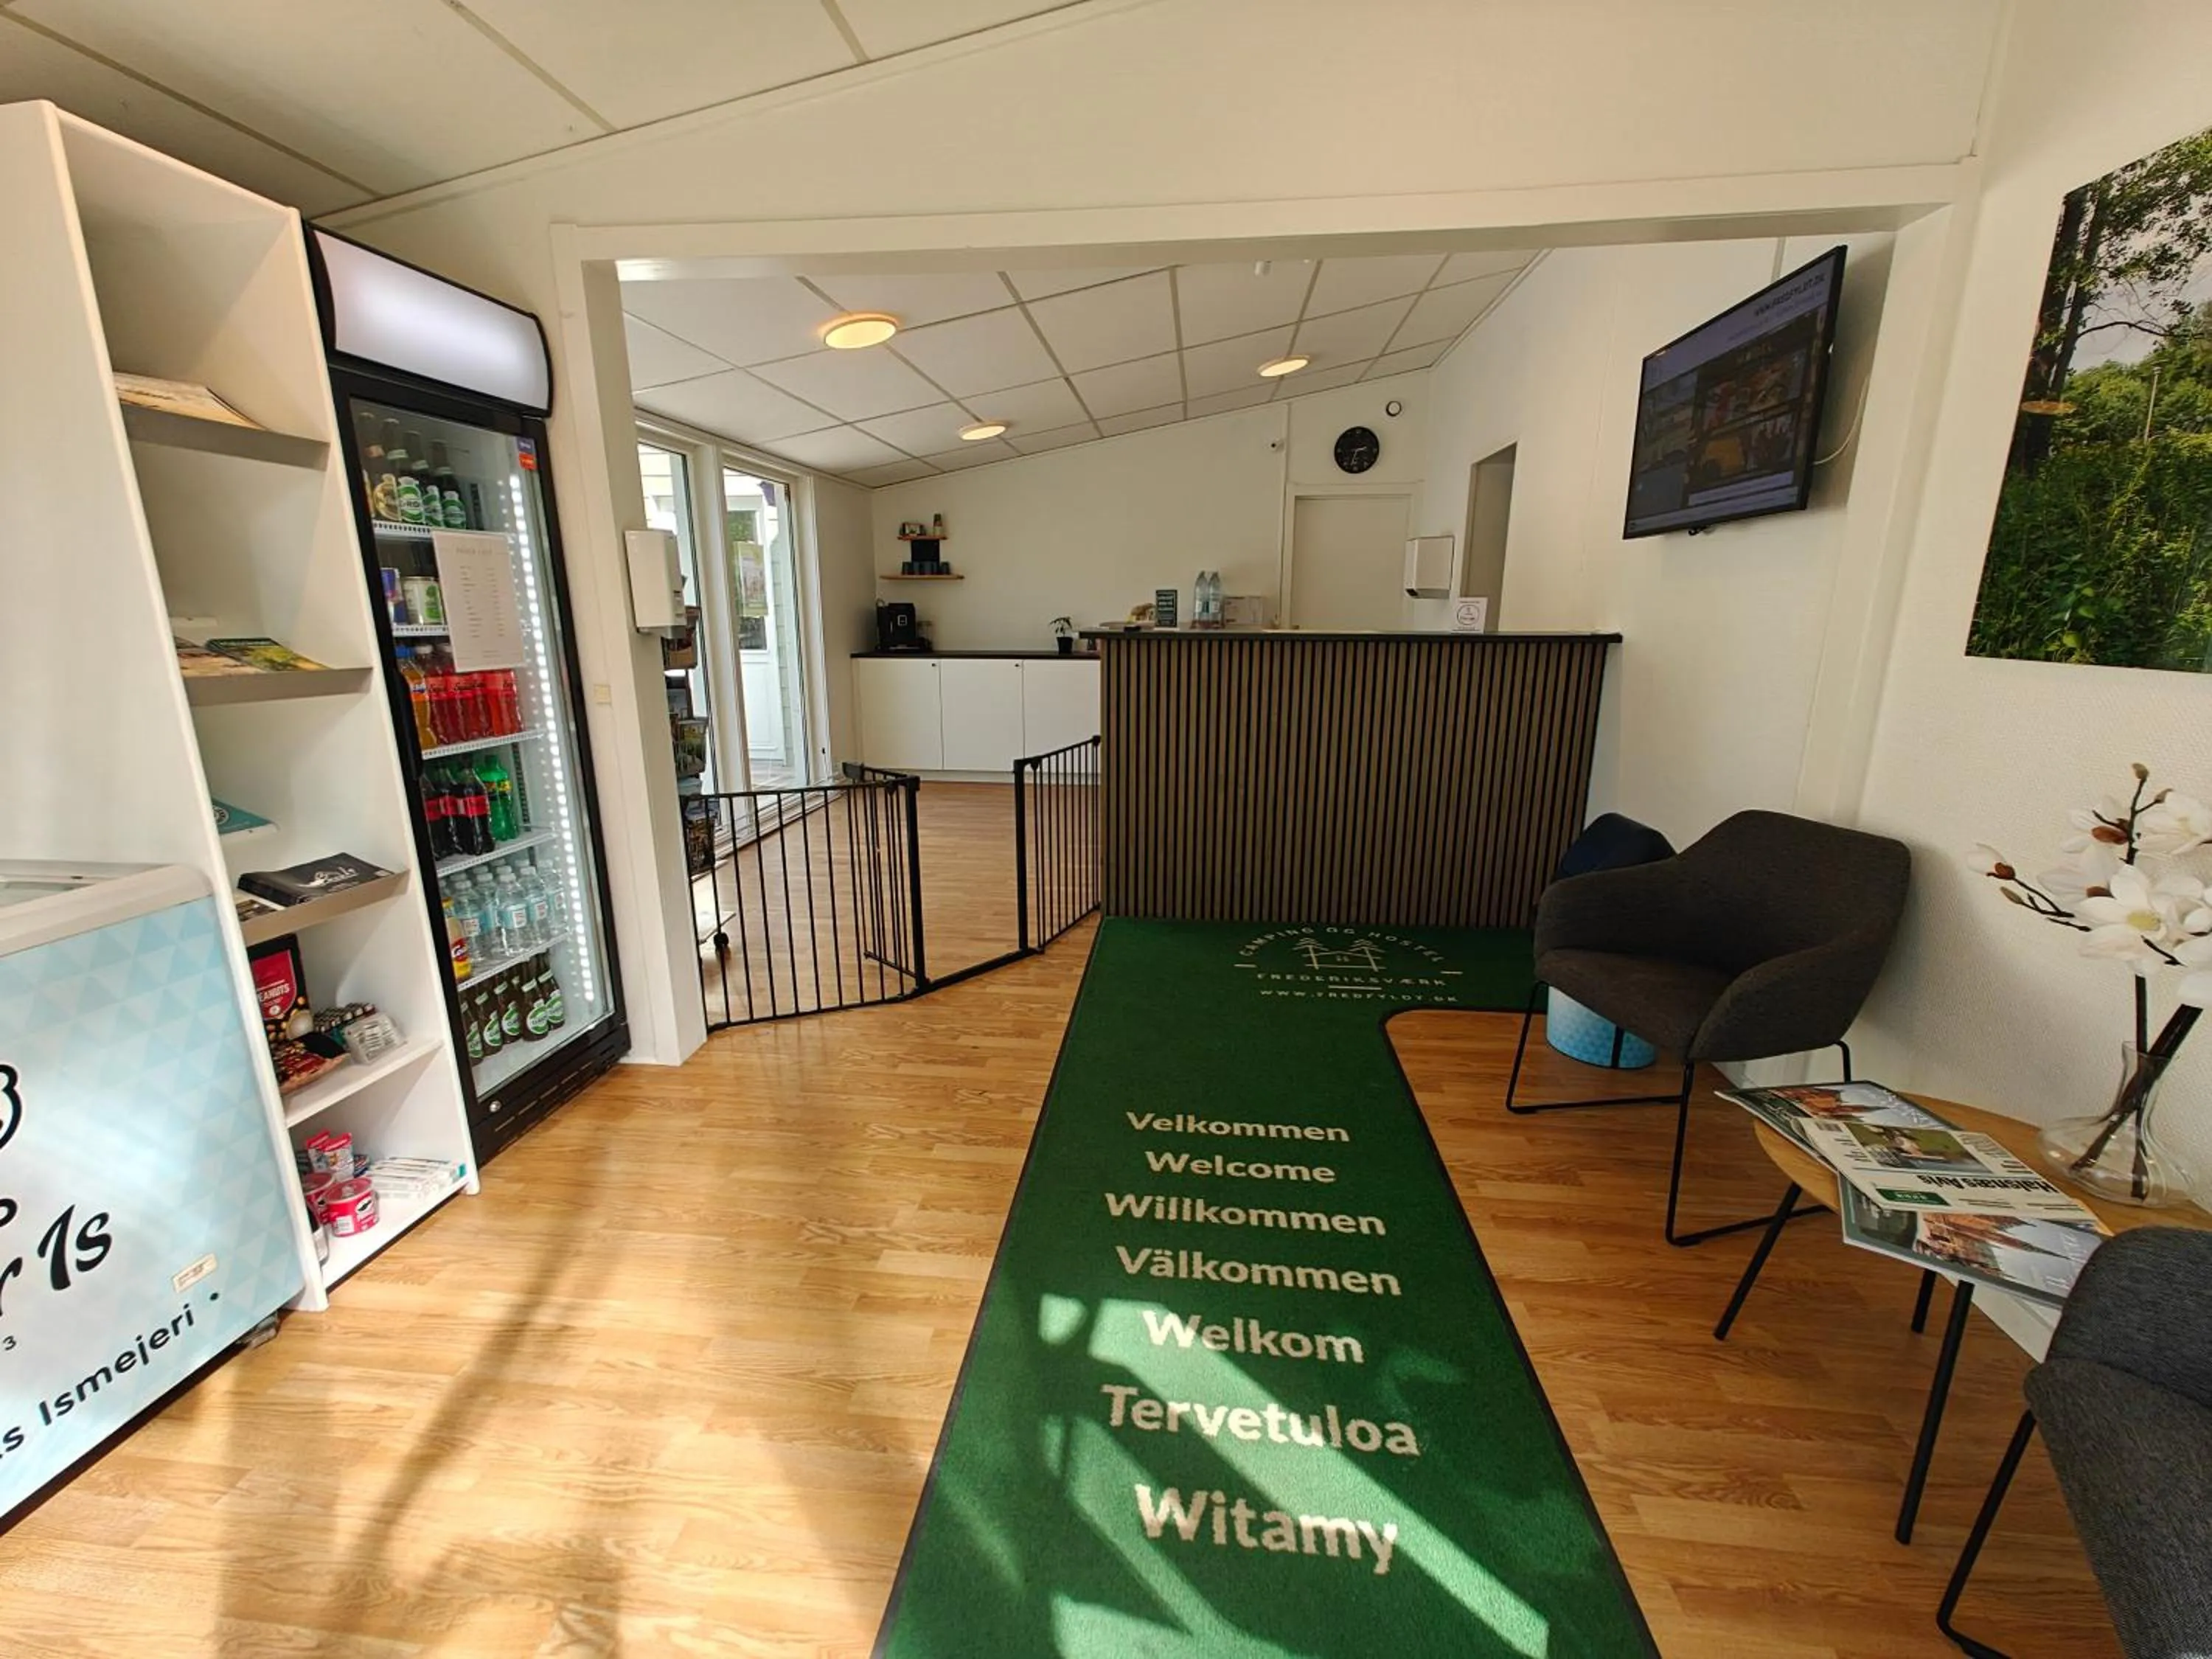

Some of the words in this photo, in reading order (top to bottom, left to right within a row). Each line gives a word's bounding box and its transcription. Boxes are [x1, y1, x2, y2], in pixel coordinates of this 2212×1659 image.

[1326, 926, 1355, 935] OG
[259, 982, 290, 1002] EANUTS
[1126, 1110, 1350, 1142] Velkommen
[1144, 1150, 1336, 1183] Welcome
[1104, 1192, 1387, 1236] Willkommen
[1115, 1245, 1402, 1296] Välkommen
[1141, 1309, 1365, 1363] Welkom
[39, 1303, 194, 1426] Ismejeri
[1100, 1384, 1420, 1456] Tervetuloa
[1134, 1483, 1398, 1575] Witamy
